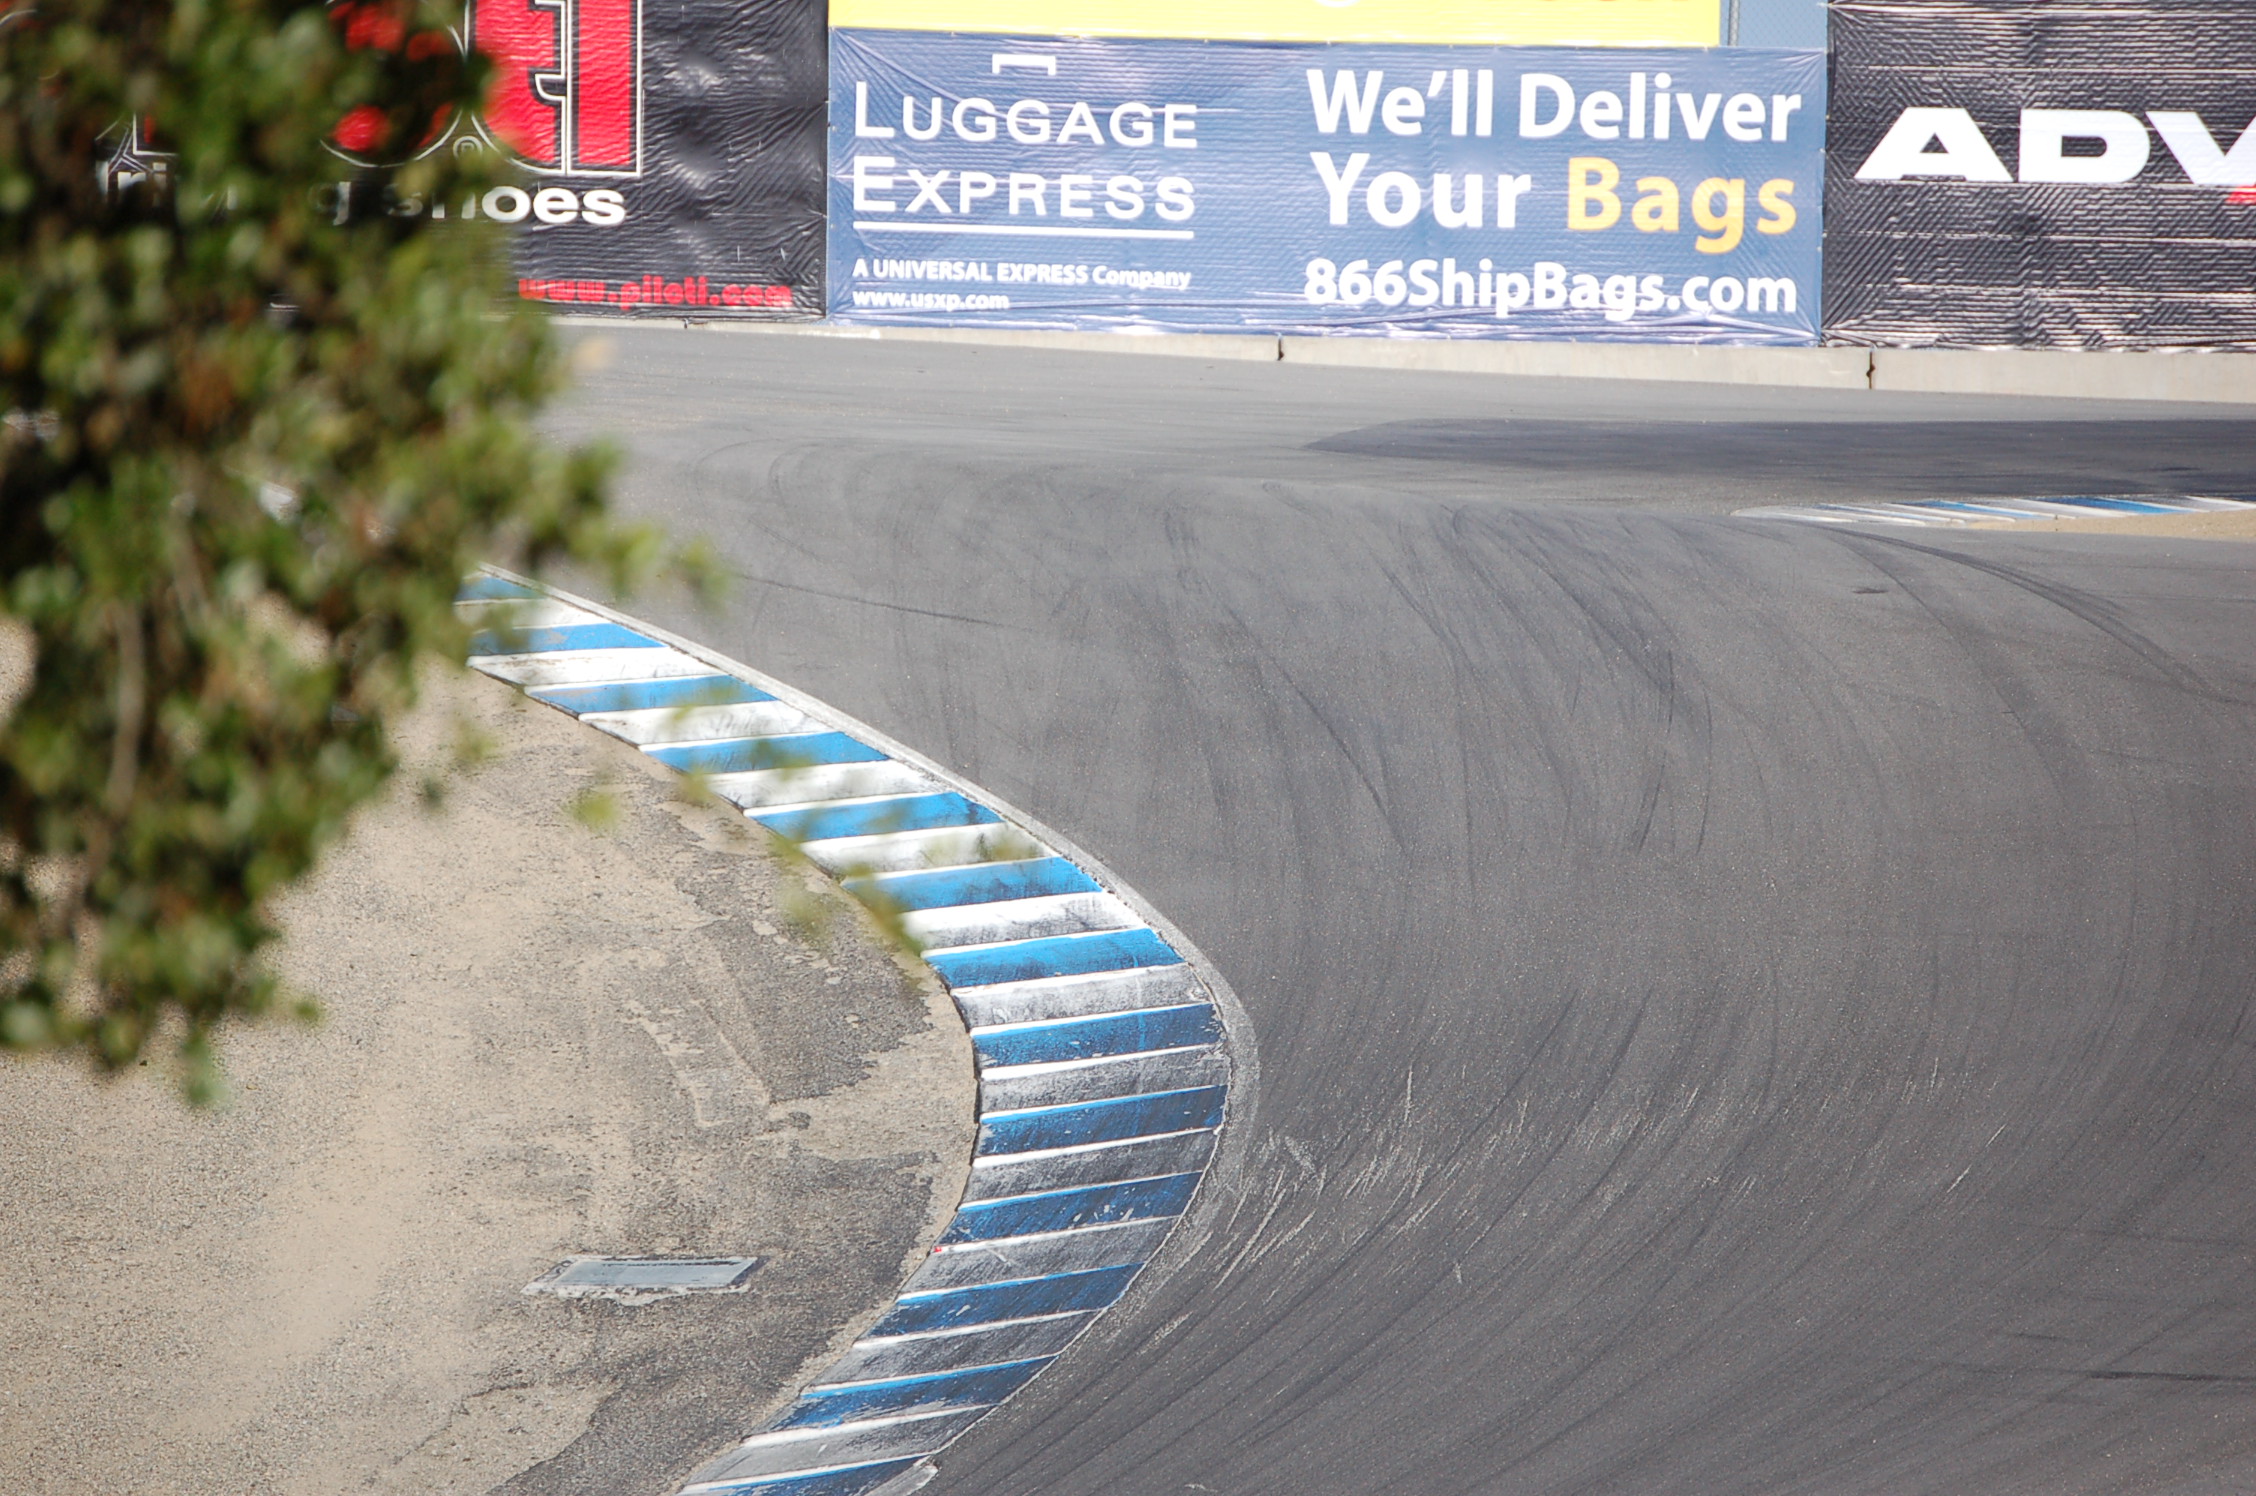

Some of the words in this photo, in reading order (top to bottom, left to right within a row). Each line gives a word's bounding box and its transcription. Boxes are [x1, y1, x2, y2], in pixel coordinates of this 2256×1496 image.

[854, 81, 1198, 149] LUGGAGE
[1306, 69, 1494, 137] We'll
[1519, 72, 1802, 143] Deliver
[853, 155, 1196, 221] EXPRESS
[1309, 151, 1532, 229] Your
[1566, 156, 1798, 254] Bags
[518, 274, 793, 310] www.piloti.com
[852, 291, 1010, 311] www.usxp.com
[853, 258, 869, 278] A
[873, 259, 991, 282] UNIVERSAL
[997, 262, 1088, 285] EXPRESS
[1092, 266, 1192, 291] Company
[1303, 258, 1797, 322] 866ShipBags.com
